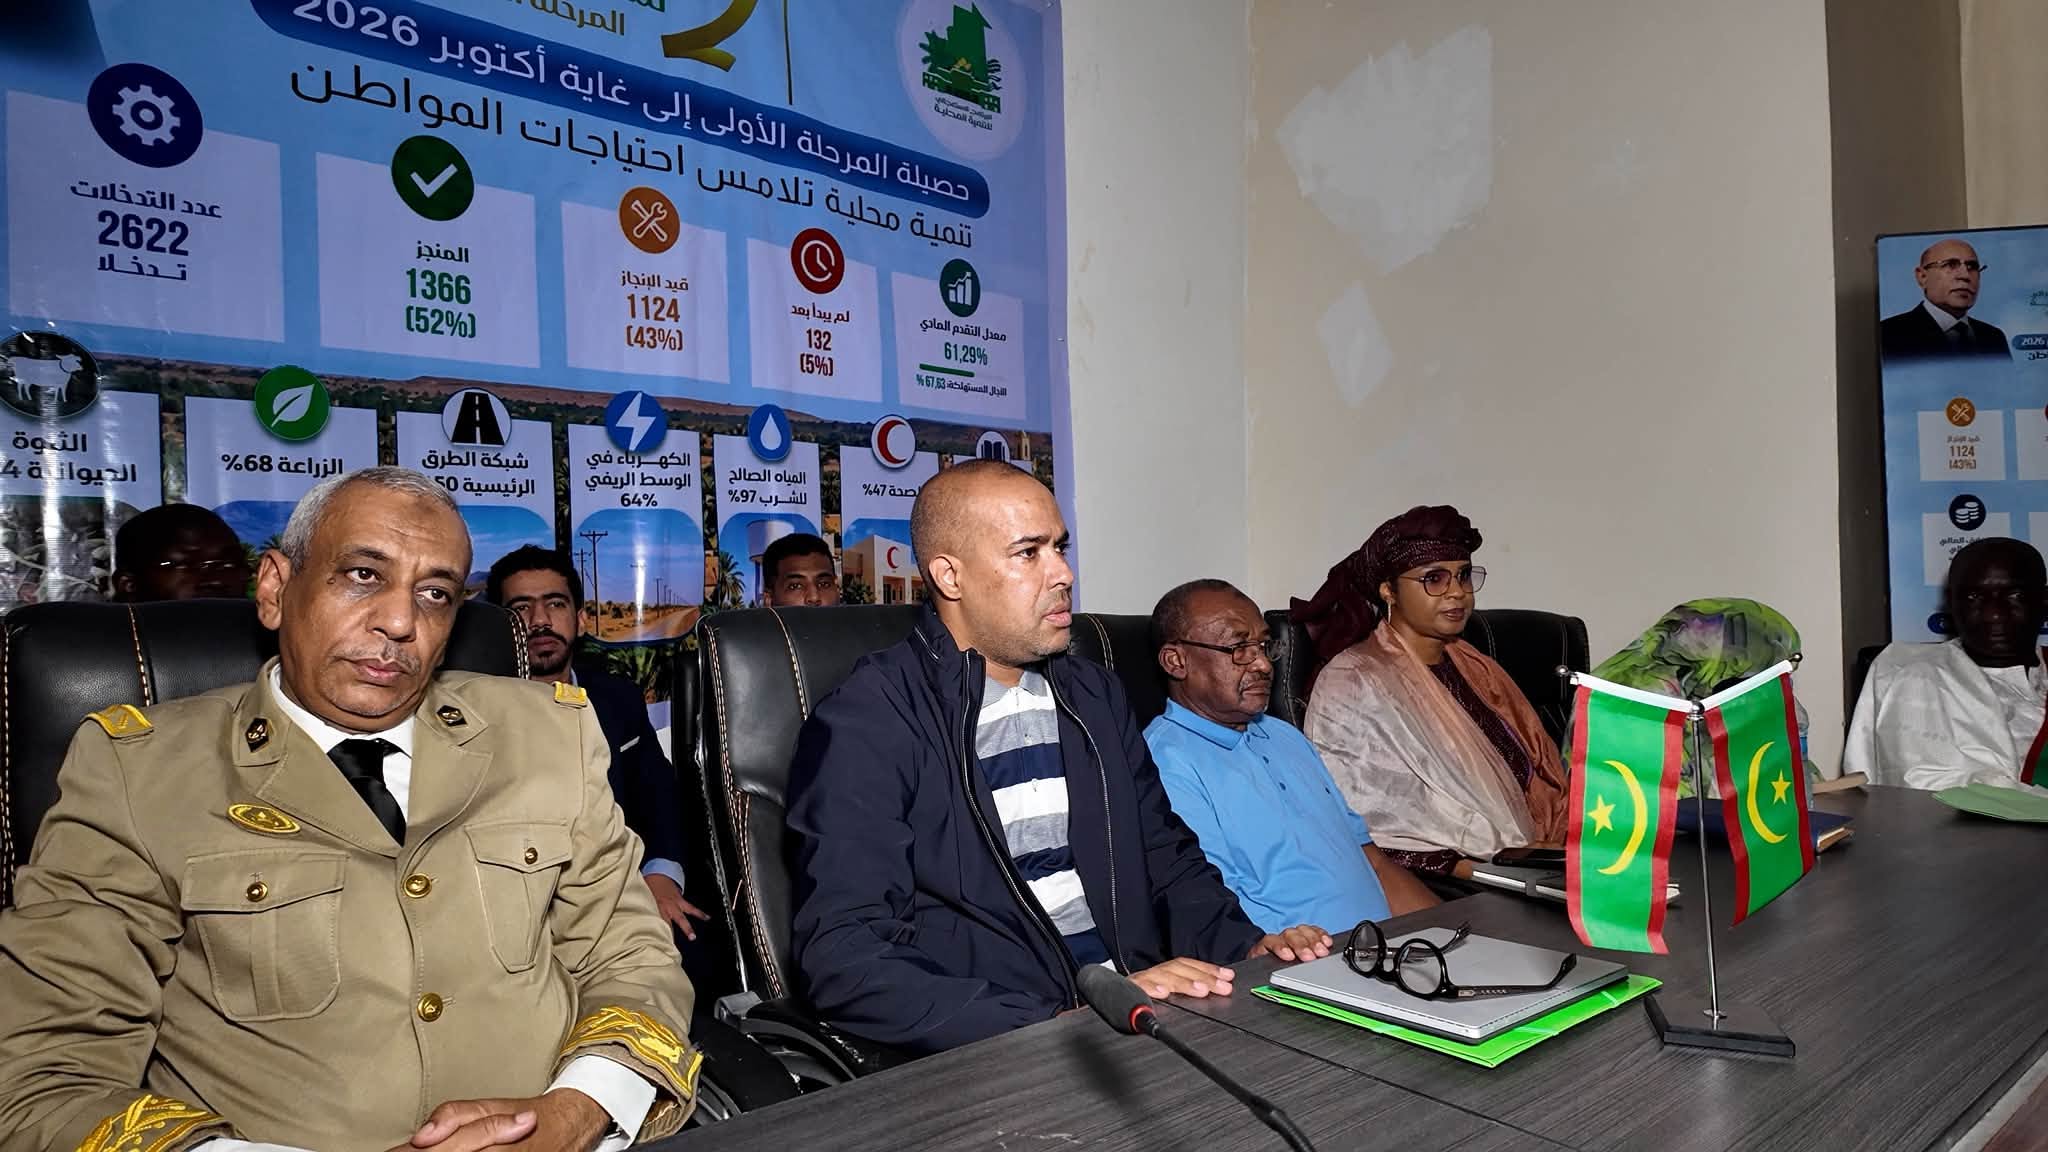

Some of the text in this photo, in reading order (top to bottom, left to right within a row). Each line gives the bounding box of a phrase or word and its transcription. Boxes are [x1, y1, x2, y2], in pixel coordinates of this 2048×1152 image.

[293, 0, 970, 201] حصيلة المرحلة الأولى إلى غاية أكتوبر 2026
[291, 64, 972, 248] تنمية محلية تلامس احتياجات المواطن
[70, 181, 223, 219] عدد التدخلات
[98, 210, 189, 256] 2622
[416, 240, 469, 263] المنجز
[406, 267, 471, 304] 1366
[621, 270, 689, 293] قيد الإنجاز
[627, 293, 681, 323] 1124
[791, 304, 810, 320] بعد
[833, 310, 850, 324] لم
[406, 305, 476, 338] (52%)
[919, 317, 1007, 342] معدل التقدم المادي
[626, 324, 683, 351] (43%)
[806, 327, 832, 351] 132
[800, 352, 834, 376] (5%)
[944, 341, 988, 366] 61,29%
[421, 450, 529, 472] شبكة الطرق
[586, 450, 613, 470] في
[1950, 445, 1975, 457] 1124
[27, 461, 137, 486] الحيوانة
[277, 456, 343, 479] الزراعة
[728, 467, 806, 487] المياه الصالح
[462, 477, 535, 498] الرئيسية
[585, 471, 691, 492] الوسط الريفي
[889, 484, 921, 498] لصحة
[620, 493, 658, 507] 64%
